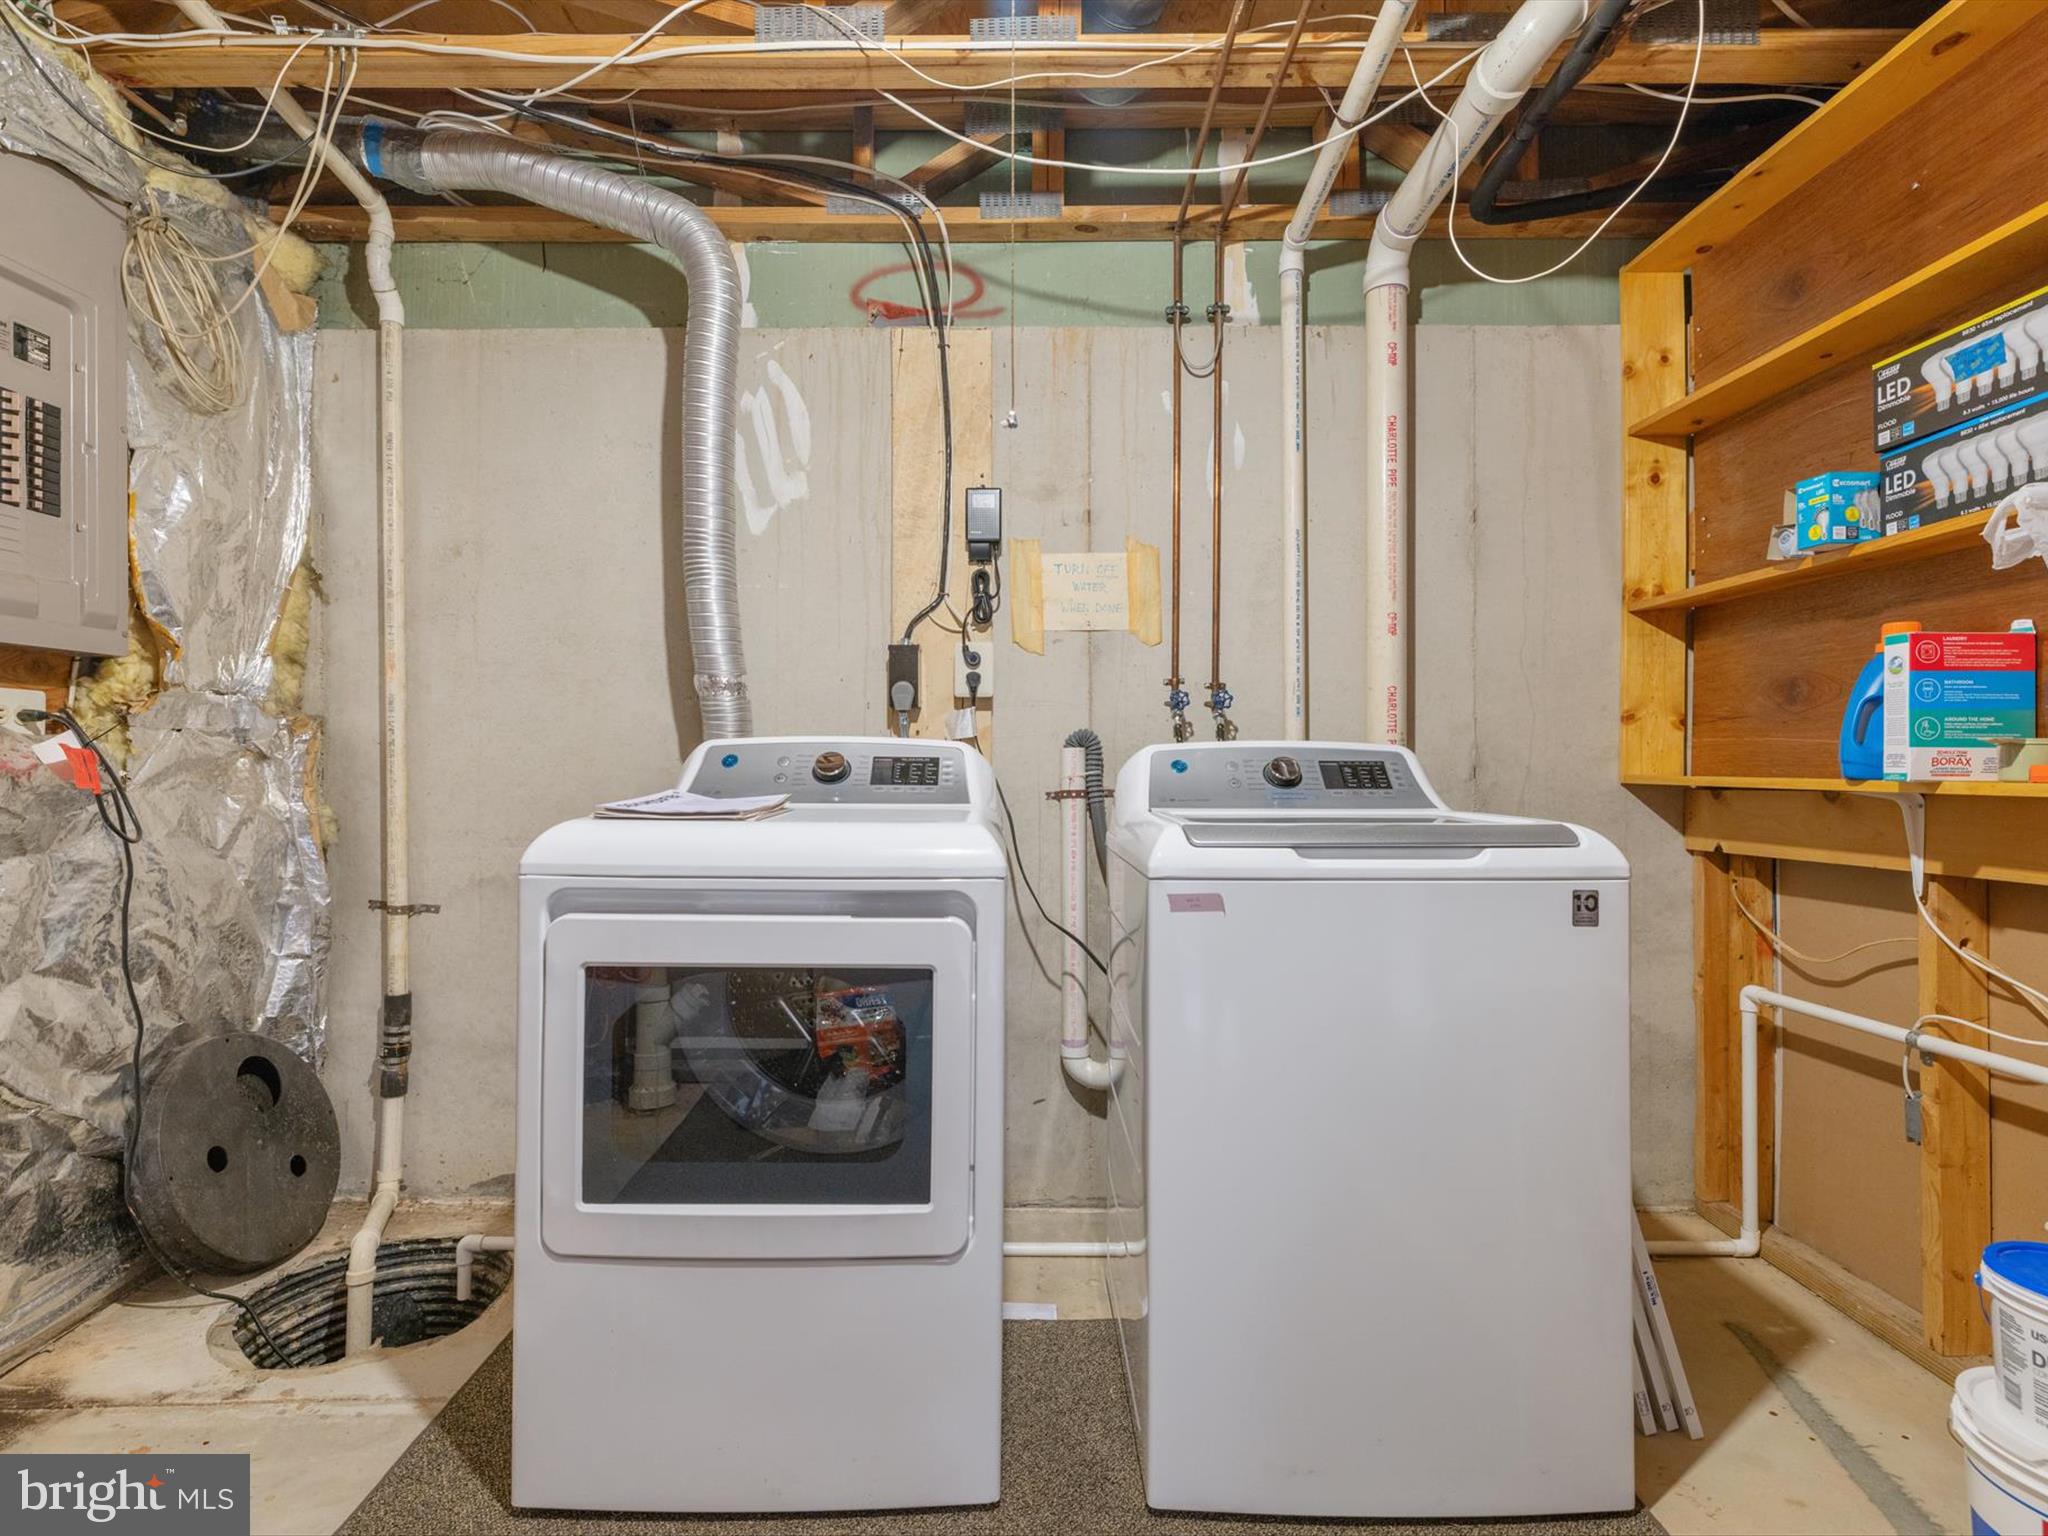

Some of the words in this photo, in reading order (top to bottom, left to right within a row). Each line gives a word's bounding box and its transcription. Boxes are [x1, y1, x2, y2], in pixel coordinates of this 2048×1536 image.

[1877, 377, 1911, 405] LED
[1877, 419, 1897, 430] FLOOD
[1990, 408, 2026, 426] replacement
[1387, 415, 1398, 463] CHARLOTTE
[1387, 469, 1398, 488] PIPE
[1885, 469, 1916, 495] LED
[1886, 511, 1903, 521] FLOOD
[1387, 685, 1397, 734] CHARLOTTE
[1931, 757, 1972, 767] BORAX
